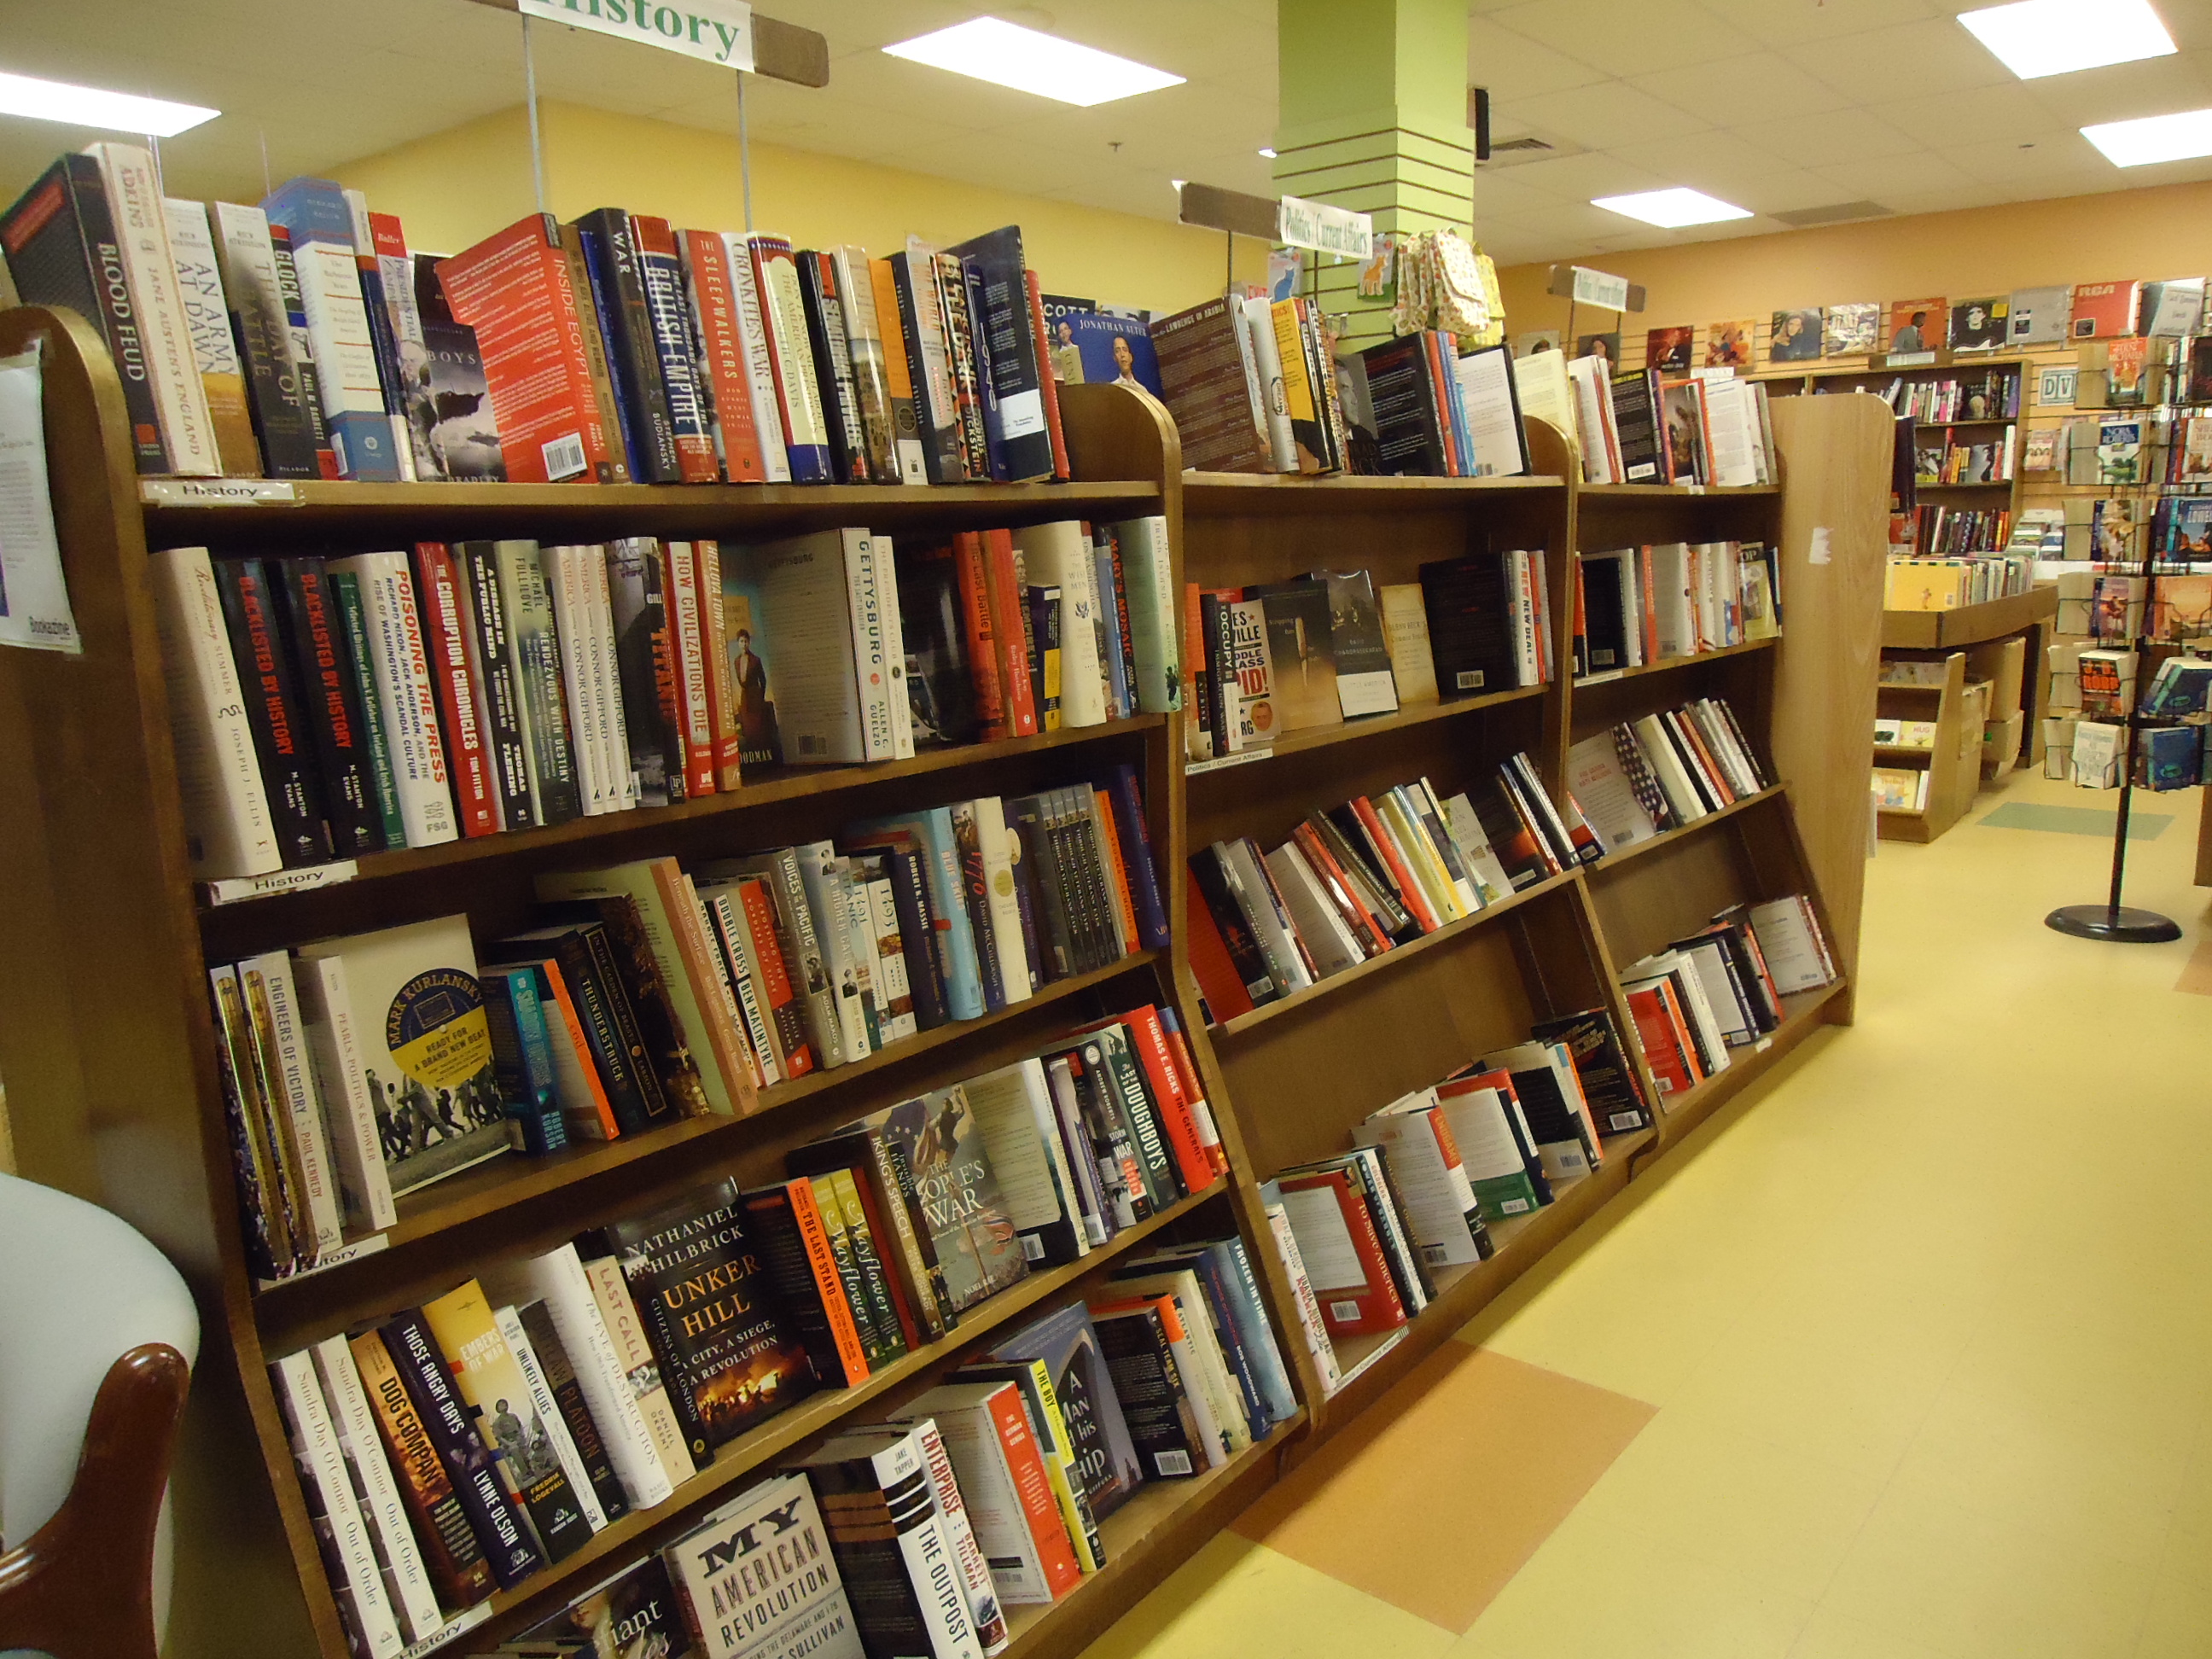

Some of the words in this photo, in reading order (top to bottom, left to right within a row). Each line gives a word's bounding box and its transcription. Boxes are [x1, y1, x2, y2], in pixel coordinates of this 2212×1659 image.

[528, 0, 740, 61] story
[613, 232, 630, 273] WAR
[1286, 207, 1311, 243] Politics
[1316, 212, 1342, 249] Current
[1344, 221, 1367, 255] Affairs
[175, 259, 198, 290] AT
[275, 249, 300, 301] GLOCK
[1249, 285, 1267, 300] EXIT
[2079, 285, 2116, 296] RCA
[97, 242, 131, 318] BLOOD
[118, 326, 146, 381] FEUD
[553, 259, 575, 317] INSIDE
[568, 321, 591, 380] EGYPT
[646, 266, 683, 345] BRITISH
[1080, 318, 1124, 333] JONATHAN
[1126, 325, 1147, 337] ALTER
[185, 301, 214, 372] DAWN
[428, 351, 476, 365] BOYS
[663, 354, 696, 425] EMPIRE
[980, 322, 997, 411] 1940
[652, 412, 670, 469] BUDIANSKY
[183, 485, 258, 498] History
[676, 555, 693, 590] HOW
[300, 573, 335, 668] BLACKLISTED
[859, 540, 882, 666] GETTYSBURG
[1110, 538, 1123, 594] MARY'S
[1117, 597, 1132, 658] MOSAIC
[239, 576, 275, 672] BLACKLISTED
[396, 569, 426, 676] POISONING
[1220, 613, 1234, 669] OCCUPY
[539, 632, 558, 701] RENDEZVOUS
[681, 597, 702, 702] CIVILIZATIONS
[260, 675, 279, 692] BY
[318, 672, 338, 689] BY
[418, 682, 434, 717] THE
[265, 696, 294, 755] HISTORY
[324, 691, 352, 748] HISTORY
[550, 704, 562, 734] WITH
[691, 708, 707, 734] DIE
[870, 704, 880, 747] GUELZO
[423, 723, 445, 784] PRESS
[554, 736, 570, 783] DESTINY
[1187, 761, 1211, 772] Politics
[1217, 756, 1242, 766] Current
[1243, 752, 1262, 760] Affairs
[255, 870, 324, 892] History
[783, 855, 801, 894] VOICES
[965, 852, 987, 895] 1776
[795, 905, 815, 947] PACIFIC
[854, 890, 868, 923] 1491
[880, 888, 896, 928] 1493
[719, 899, 736, 939] DOUBLE
[731, 941, 749, 974] CROSS
[269, 976, 293, 1045] ENGINEERS
[387, 1000, 408, 1045] MARK
[403, 974, 483, 1003] KURLANSKY
[740, 983, 755, 1005] BEN
[283, 1045, 296, 1062] OF
[426, 1037, 451, 1053] READY
[453, 1027, 468, 1039] FOR
[582, 978, 625, 1082] THUNDERSTRUCK
[747, 1006, 774, 1068] MACINTYRE
[1120, 1068, 1137, 1080] LAST
[1146, 1016, 1166, 1057] THOMAS
[1160, 1057, 1167, 1067] E.
[1164, 1066, 1180, 1094] RICKS
[286, 1064, 306, 1115] VICTORY
[1095, 1069, 1107, 1093] ANDREW
[1103, 1093, 1116, 1121] ROBERTS
[300, 1132, 314, 1156] PAUL
[1109, 1128, 1126, 1142] STORM
[1114, 1141, 1133, 1160] WAR
[1124, 1084, 1167, 1171] DOUGHBOYS
[1174, 1095, 1186, 1115] THE
[1182, 1116, 1204, 1163] GENERALS
[305, 1158, 323, 1199] KENNEDY
[873, 1139, 894, 1185] KING'S
[888, 1186, 911, 1238] SPEECH
[802, 1211, 817, 1233] THE
[923, 1187, 984, 1228] WAR
[625, 1205, 739, 1259] NATHANIEL
[809, 1237, 825, 1260] LAST
[817, 1262, 836, 1296] STAND
[826, 1210, 869, 1324] Mayflower
[847, 1200, 890, 1313] Mayflower
[1234, 1243, 1254, 1284] FROZEN
[1249, 1285, 1258, 1298] IN
[1254, 1298, 1269, 1325] TIME
[598, 1266, 620, 1311] LAST
[616, 1313, 643, 1363] CALL
[679, 1292, 752, 1339] HILL
[458, 1327, 502, 1363] EMBERS
[468, 1353, 484, 1372] OF
[482, 1343, 506, 1365] WAR
[650, 1297, 675, 1352] CITIZENS
[669, 1353, 682, 1371] OF
[676, 1371, 699, 1423] LONDON
[689, 1375, 699, 1387] A
[700, 1335, 779, 1382] REVOLUTION
[690, 1343, 725, 1366] CITY,
[726, 1337, 736, 1348] A
[735, 1321, 777, 1345] SIEGE,
[402, 1324, 431, 1365] THOSE
[424, 1366, 451, 1408] ANGRY
[439, 1400, 465, 1436] DAYS
[516, 1348, 543, 1397] UNLIKELY
[531, 1388, 552, 1417] ALLIES
[1036, 1368, 1051, 1391] THE
[1043, 1389, 1057, 1408] BOY
[1241, 1361, 1260, 1406] WOODWARD
[297, 1371, 319, 1421] Sandra
[313, 1417, 330, 1448] Day
[323, 1452, 350, 1516] O'Connor
[336, 1356, 359, 1406] Sandra
[351, 1406, 367, 1432] Day
[362, 1434, 389, 1497] O'Connor
[650, 1410, 669, 1452] OKRENT
[657, 1408, 675, 1446] DANIEL
[894, 1448, 908, 1462] JAKE
[894, 1458, 915, 1476] TAPPER
[920, 1429, 963, 1518] ENTERPRISE
[473, 1469, 501, 1511] LYNNE
[491, 1505, 520, 1548] OLSON
[531, 1477, 566, 1505] LOGEVALL
[345, 1521, 362, 1545] Out
[384, 1502, 402, 1529] Out
[697, 1495, 802, 1579] MY
[352, 1548, 367, 1564] of
[393, 1531, 407, 1549] of
[963, 1532, 988, 1585] BARRETT
[357, 1565, 377, 1608] Order
[399, 1550, 419, 1586] Order
[710, 1526, 821, 1620] AMERICAN
[918, 1524, 938, 1564] THE
[930, 1563, 969, 1644] OUTPOST
[955, 1539, 980, 1592] TILLMAN
[720, 1563, 830, 1648] REVOLUTION
[400, 1621, 463, 1659] History
[788, 1615, 845, 1659] SULLIVAN
